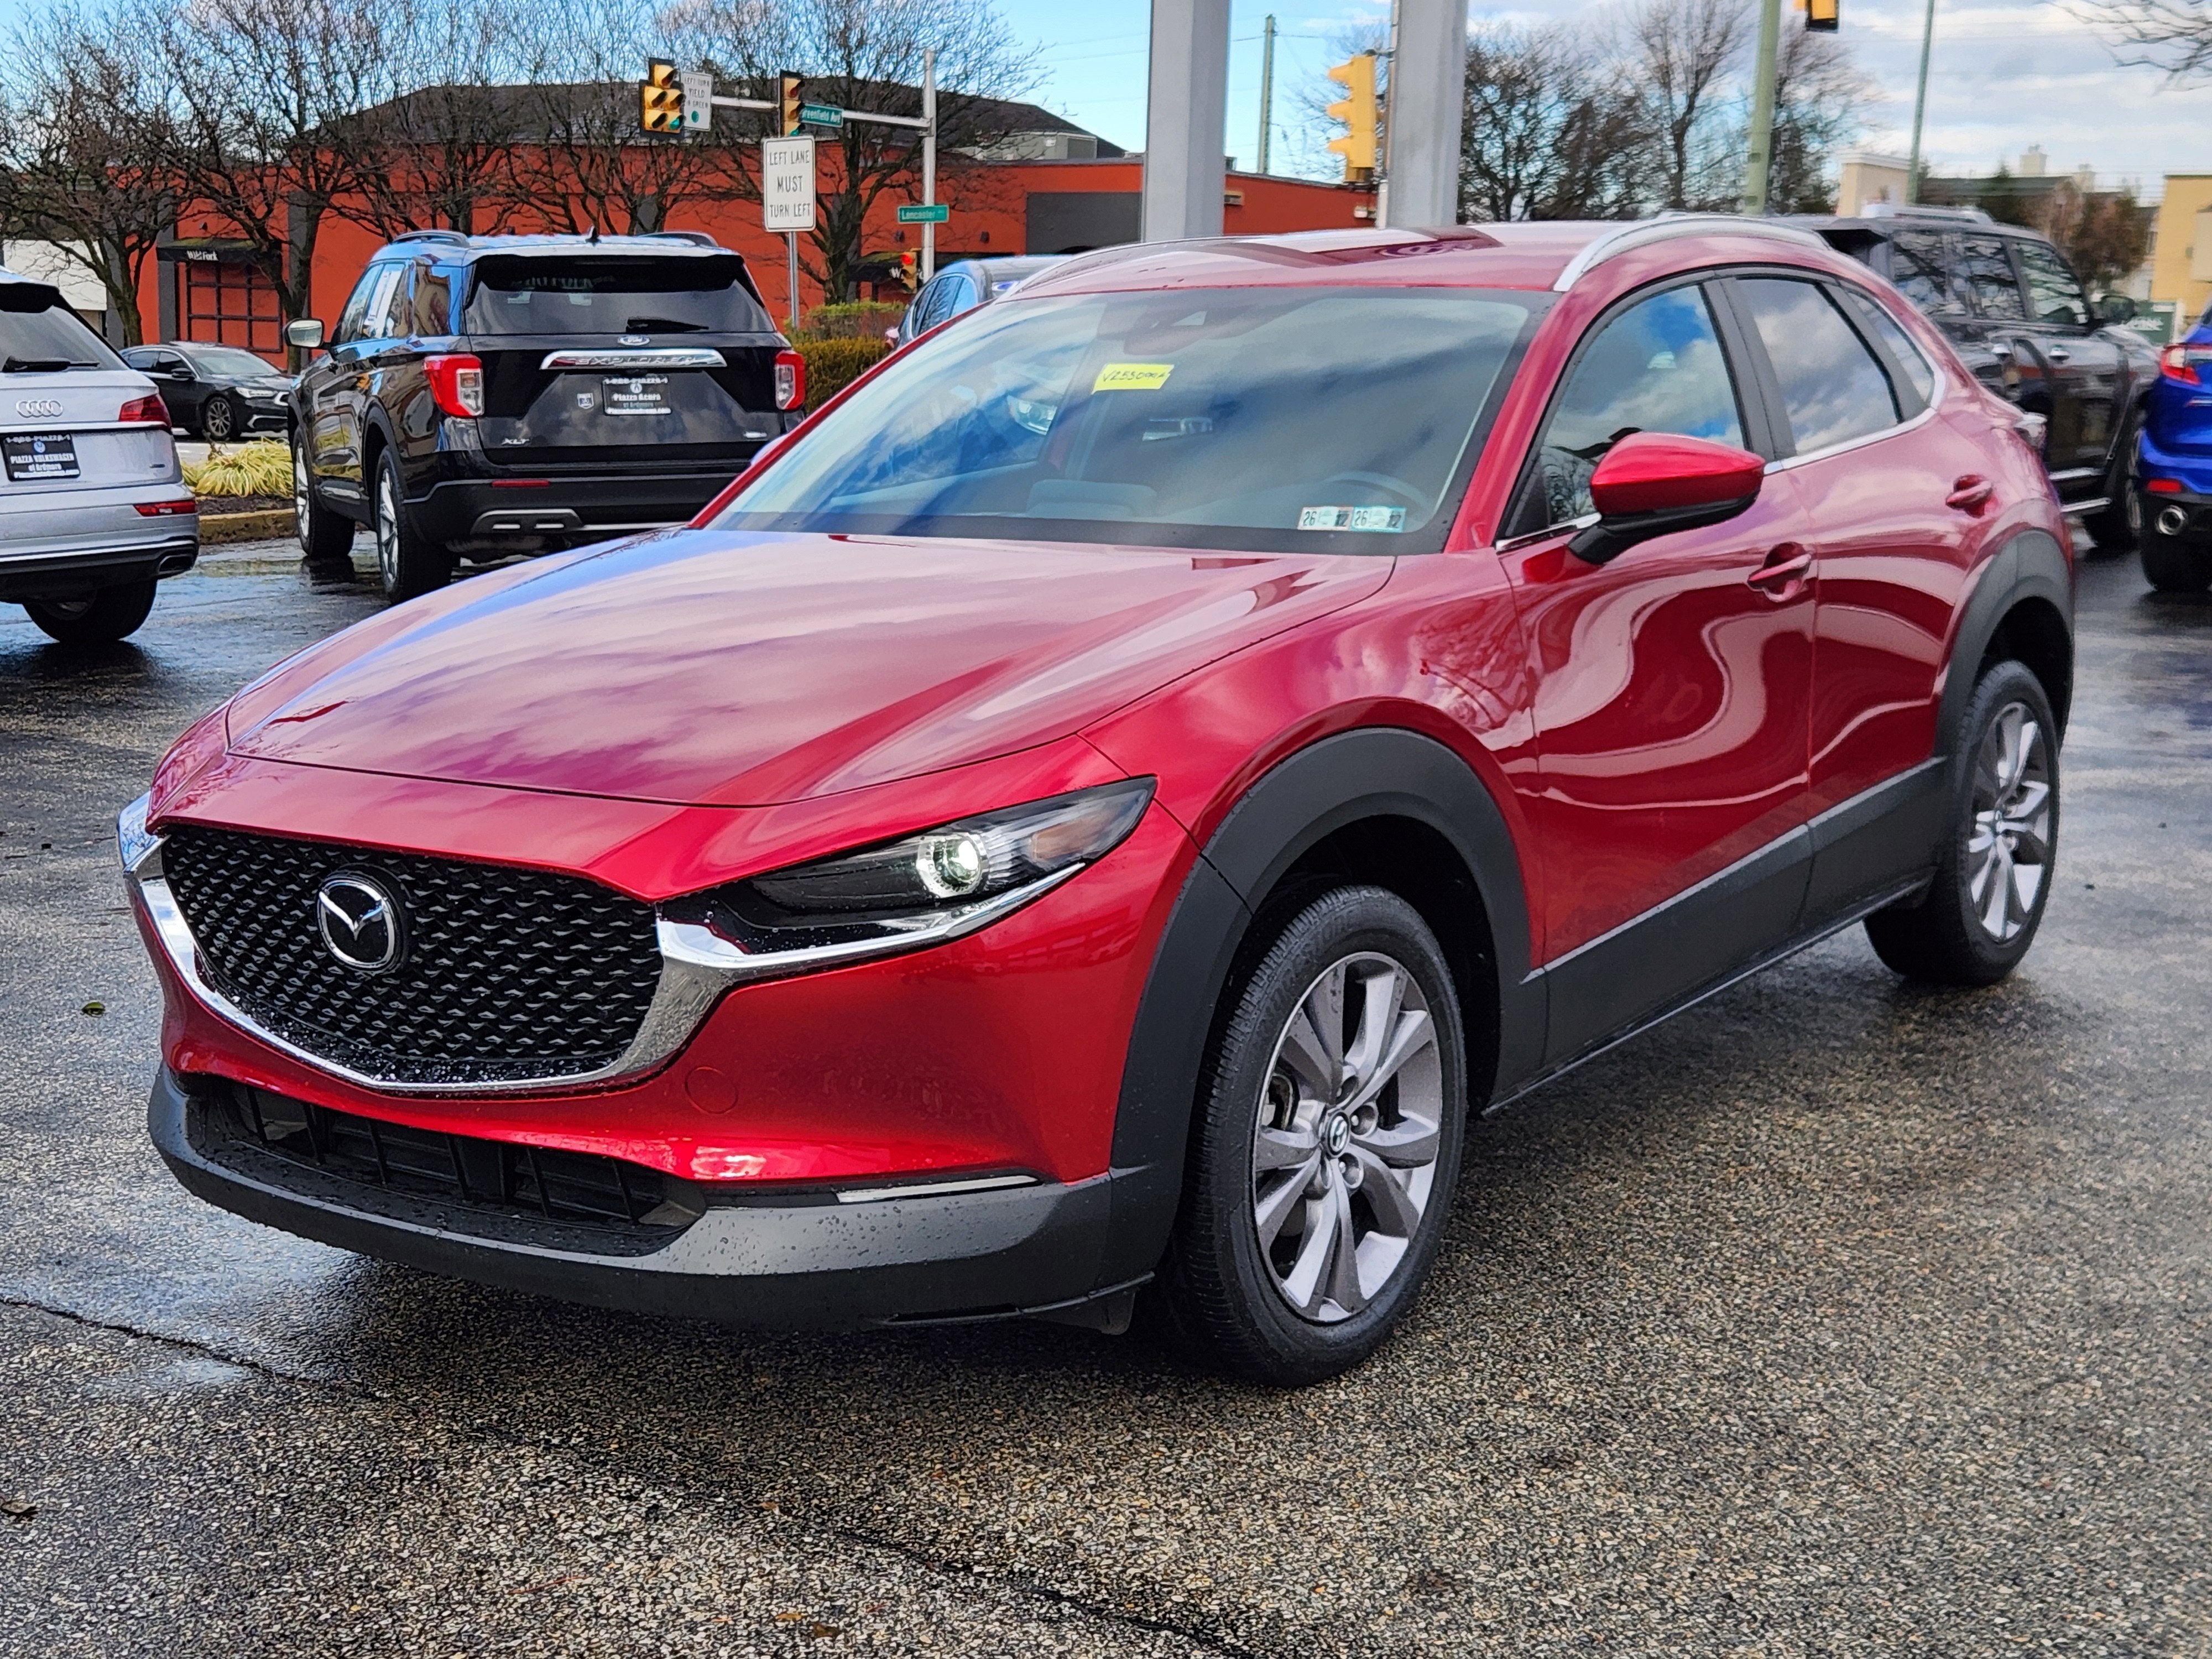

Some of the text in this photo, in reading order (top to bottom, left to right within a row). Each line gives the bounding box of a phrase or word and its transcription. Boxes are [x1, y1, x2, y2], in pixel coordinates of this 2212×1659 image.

[688, 87, 705, 98] YIELD
[802, 109, 830, 122] reenfield
[769, 149, 810, 166] LEFT LANE
[776, 175, 803, 194] MUST
[769, 202, 811, 218] TURN LEFT
[202, 251, 218, 261] Fork
[574, 356, 699, 366] EXPLORER
[10, 455, 34, 465] PIAZZA
[1302, 510, 1317, 526] 26
[1355, 510, 1368, 526] 26
